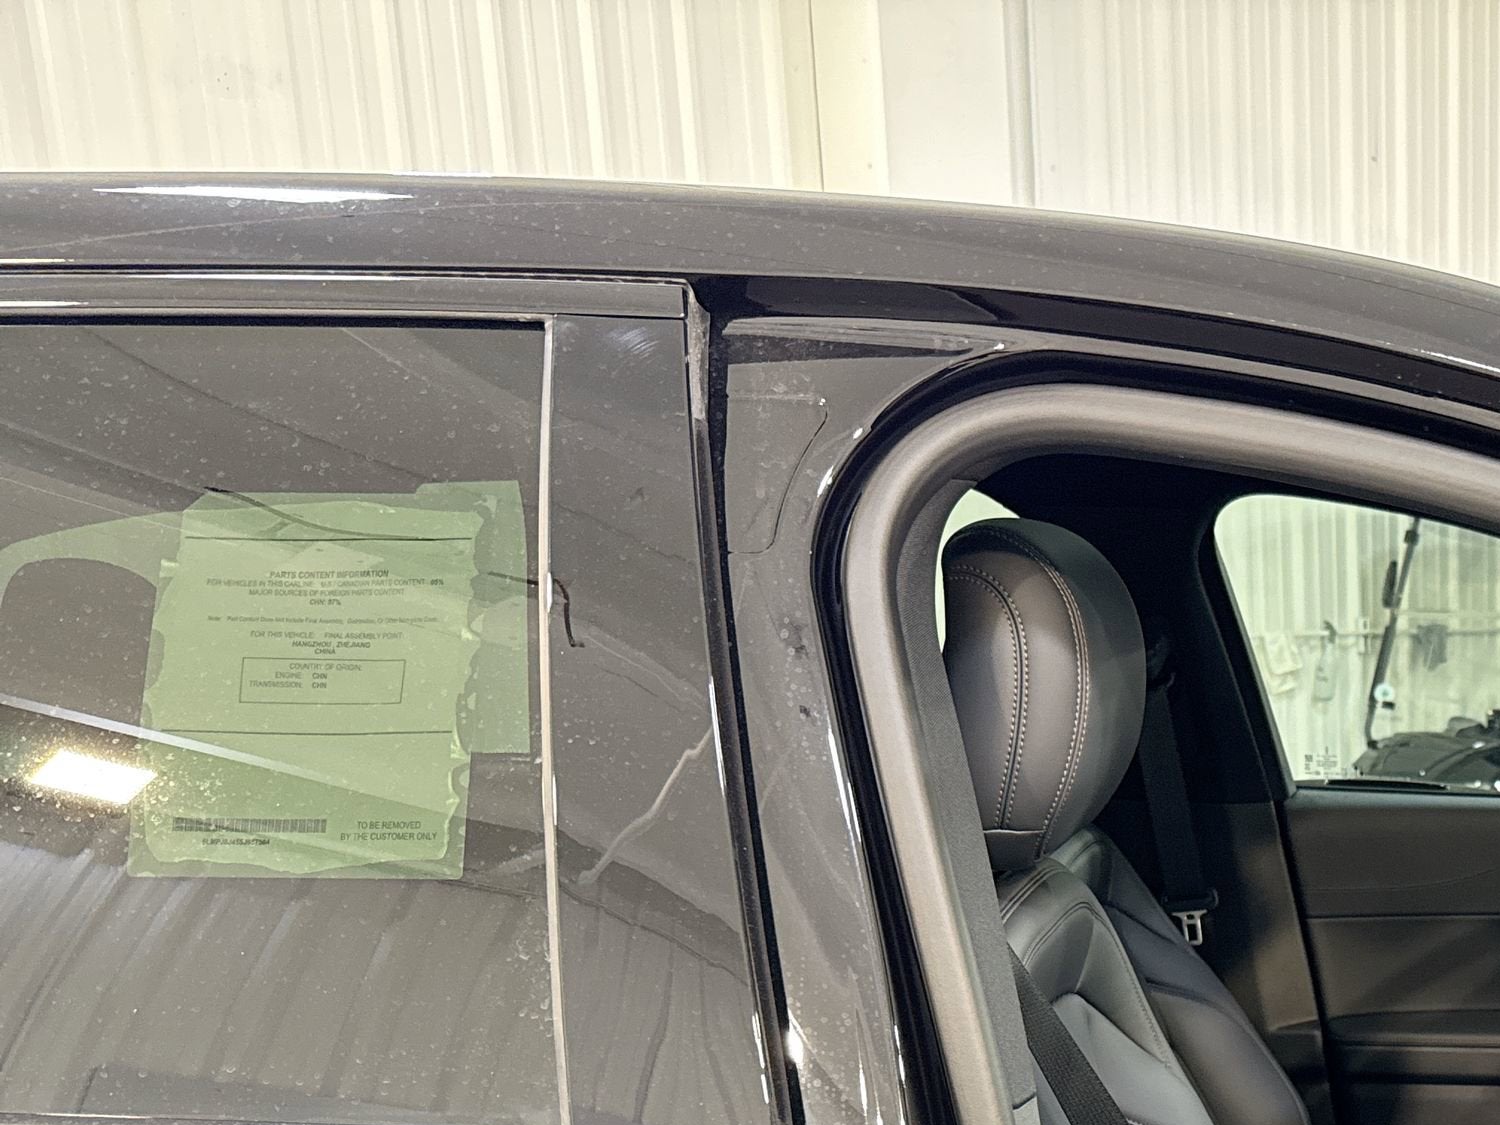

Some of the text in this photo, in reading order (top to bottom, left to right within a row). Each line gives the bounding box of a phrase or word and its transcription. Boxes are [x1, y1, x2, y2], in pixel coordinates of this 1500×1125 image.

[270, 569, 389, 579] PARTS CONTENT INFORMATION
[250, 630, 266, 638] FOR
[267, 630, 282, 638] THIS
[314, 648, 336, 656] CHINA
[289, 662, 322, 671] COUNTRY
[324, 663, 334, 671] OF
[312, 672, 328, 680] CHN
[312, 681, 327, 689] CHN
[357, 821, 422, 830] TO BE REMOVED
[340, 831, 437, 841] BY THE CUSTOMER ONLY
